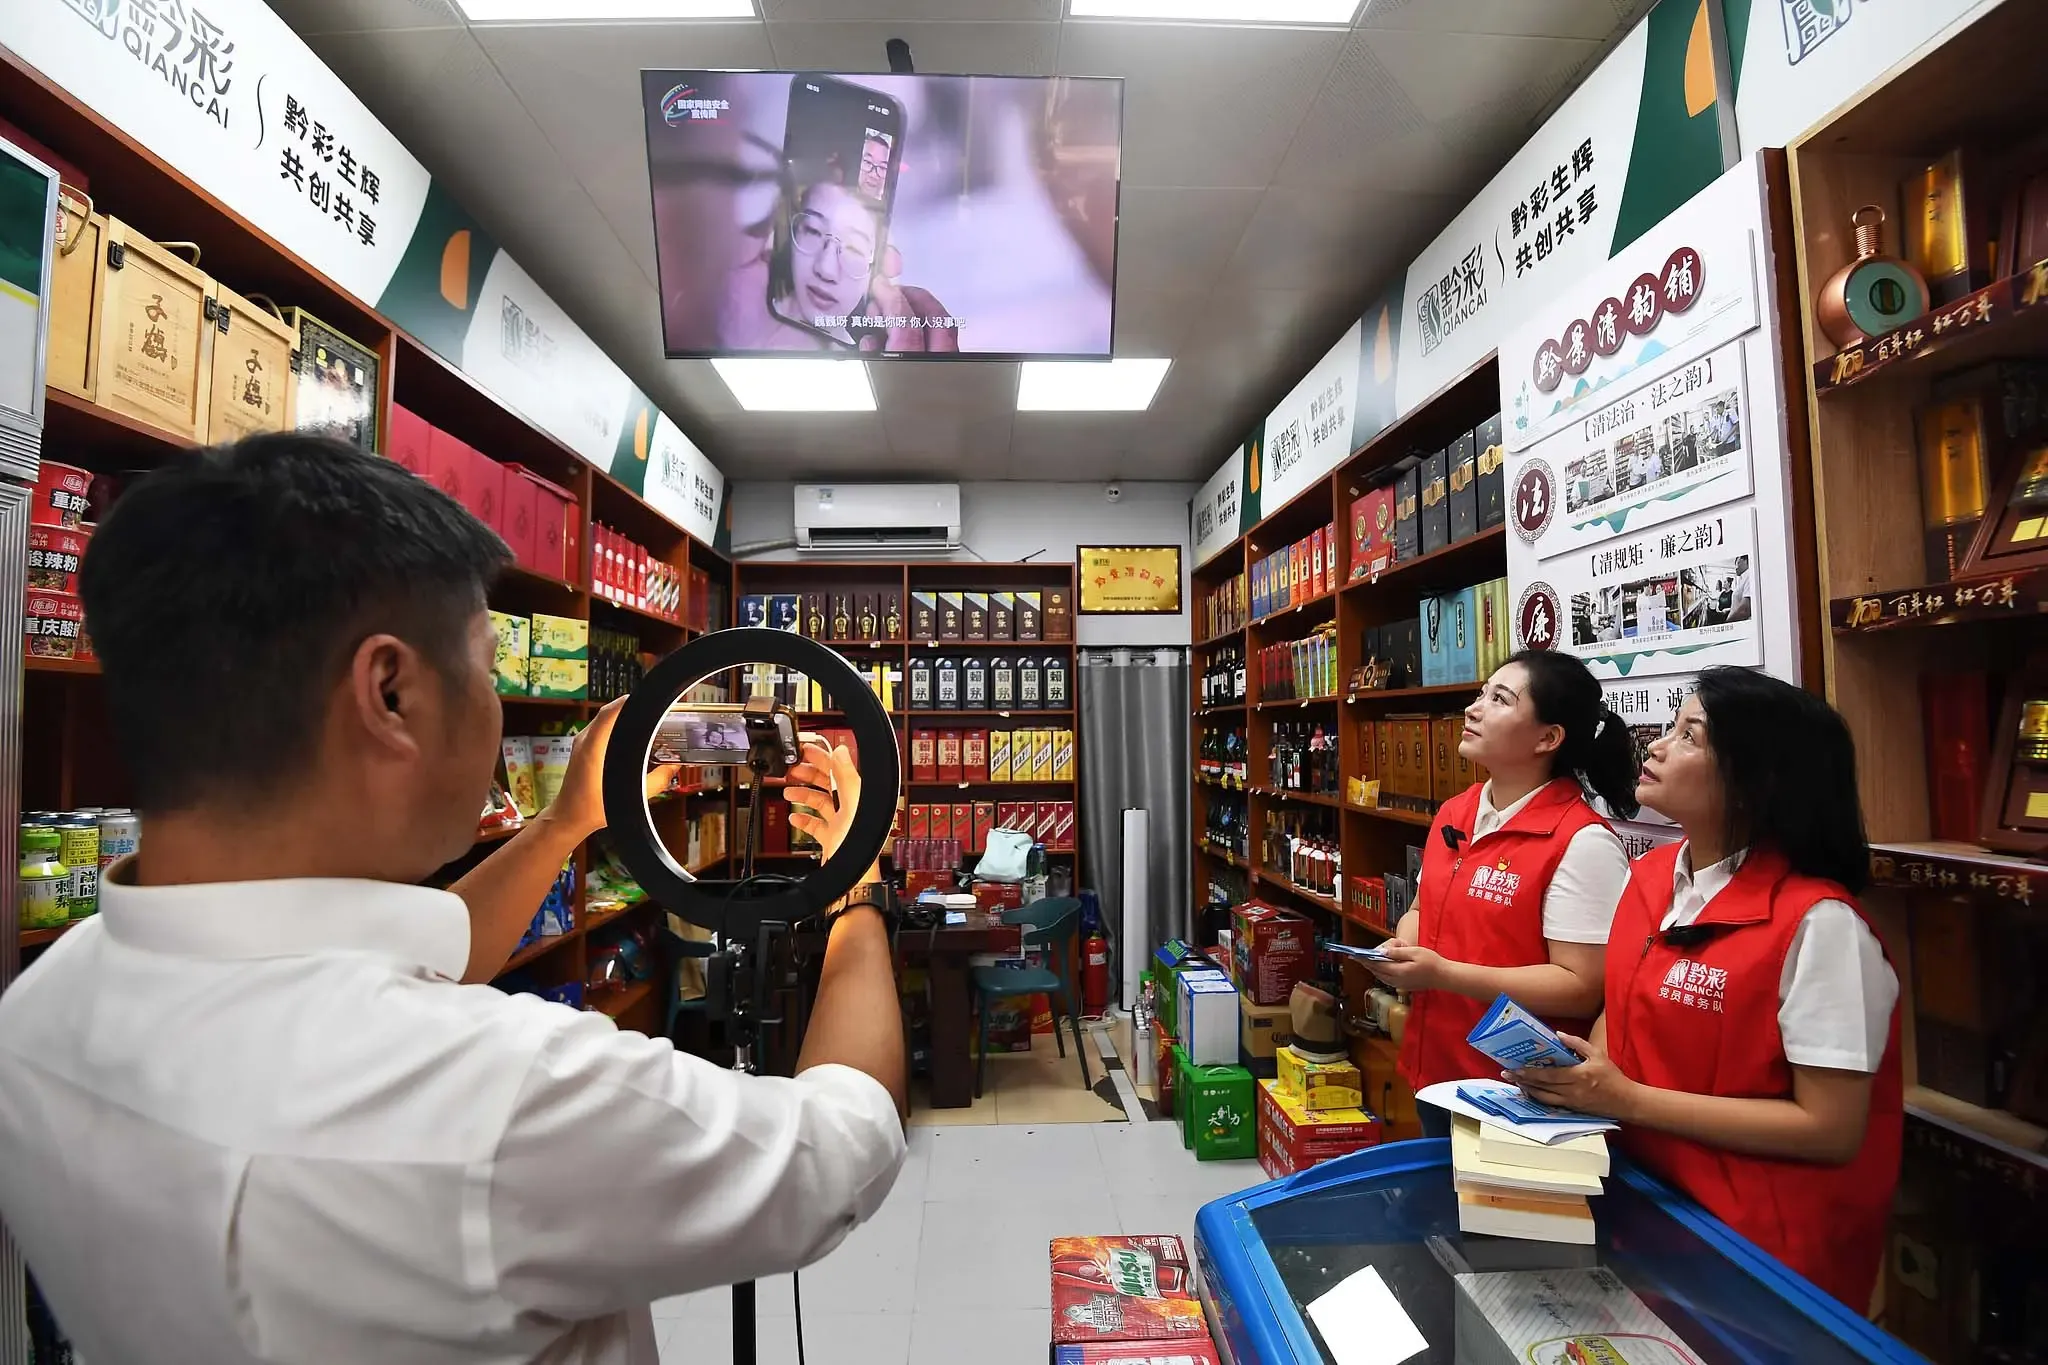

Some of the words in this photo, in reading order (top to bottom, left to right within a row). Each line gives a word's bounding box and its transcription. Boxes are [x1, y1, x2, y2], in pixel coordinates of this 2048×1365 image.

[123, 28, 230, 130] QIANCAI
[284, 94, 381, 206] 黔彩生辉
[280, 147, 377, 249] 共创共享
[1510, 137, 1594, 240] 黔彩生辉
[1515, 184, 1598, 279] 共创共享
[1440, 242, 1485, 319] 黔彩
[851, 316, 907, 328] 真的是你呀
[1443, 287, 1488, 337] QIANCAI
[1521, 476, 1545, 523] 法
[1606, 687, 1697, 714] 清信用·诚
[1617, 832, 1655, 857] 市场
[1485, 883, 1515, 896] QIANCAI
[1491, 869, 1521, 890] 黔彩
[1467, 887, 1513, 907] 党员服务队
[1687, 962, 1728, 990] 黔彩
[1658, 986, 1724, 1013] 党员服务队
[1684, 982, 1724, 999] QIANCAI
